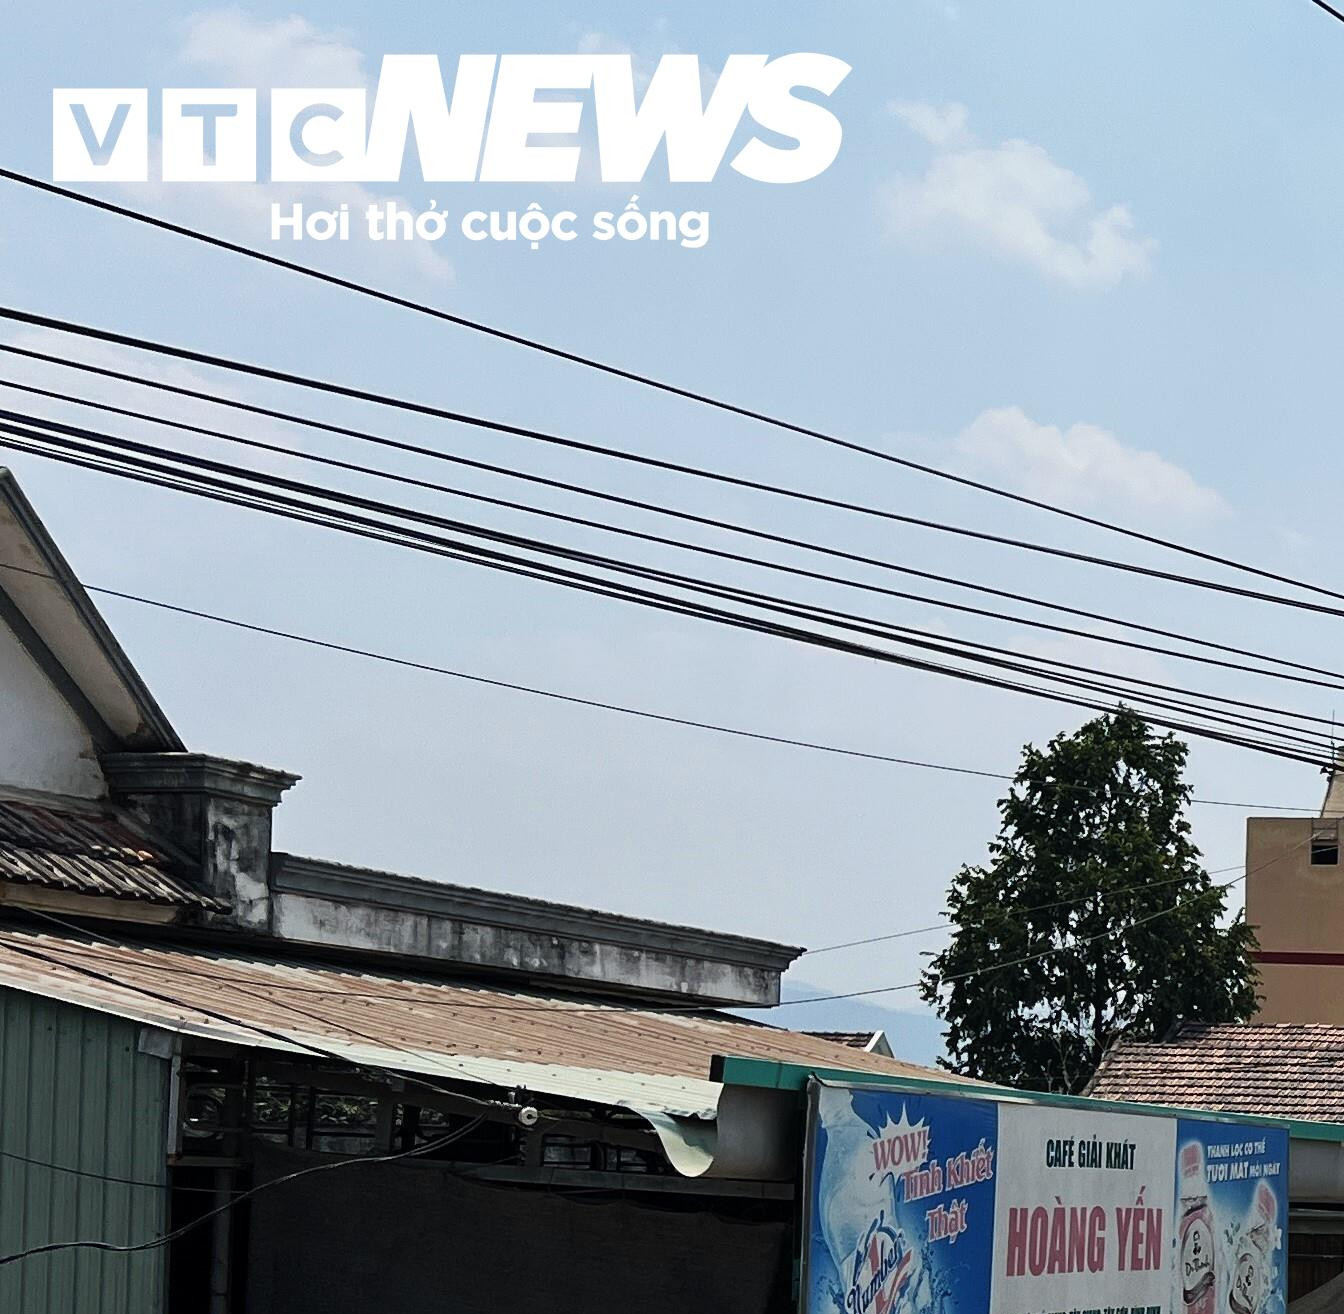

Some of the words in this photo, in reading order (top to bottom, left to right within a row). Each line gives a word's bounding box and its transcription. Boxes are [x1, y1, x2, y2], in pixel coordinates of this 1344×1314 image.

[872, 1129, 929, 1172] WOW!
[1046, 1136, 1075, 1168] CAFÉ
[1078, 1134, 1102, 1168] GIẢI
[1105, 1138, 1137, 1170] KHÁT
[1006, 1196, 1106, 1277] HOÀNG
[1115, 1185, 1163, 1271] YẾN
